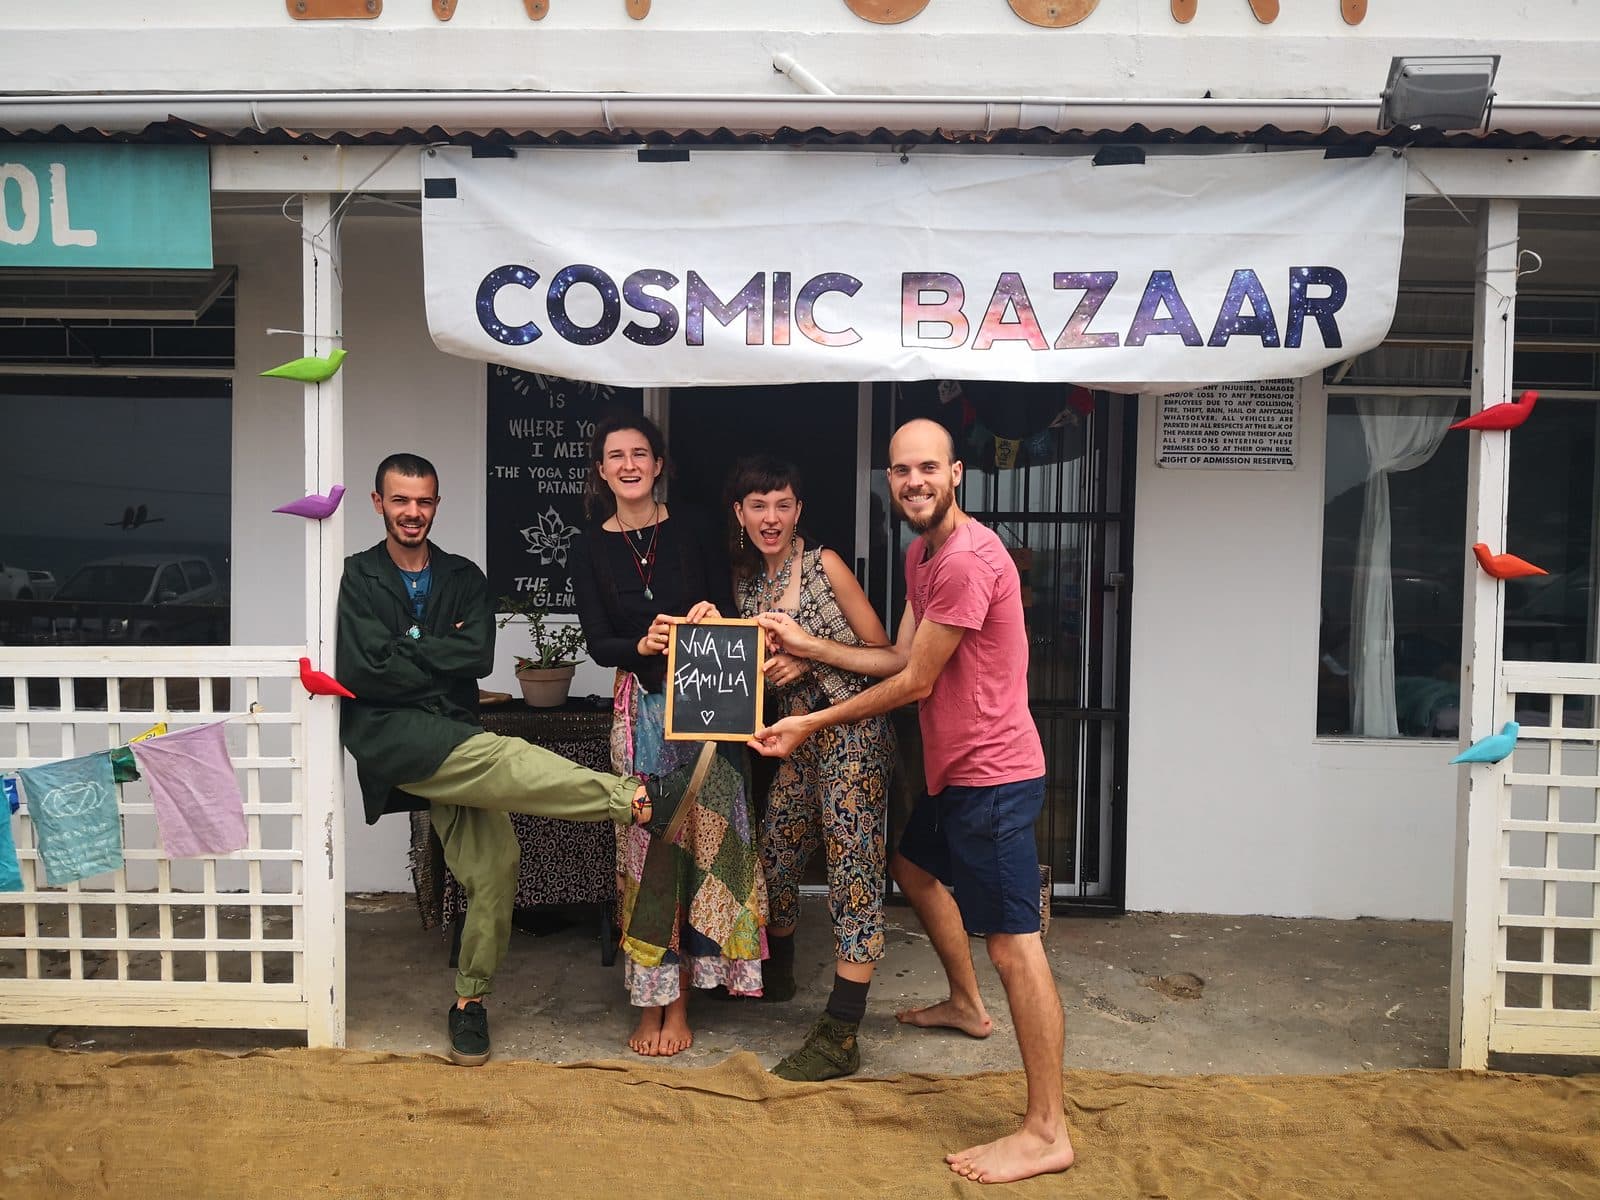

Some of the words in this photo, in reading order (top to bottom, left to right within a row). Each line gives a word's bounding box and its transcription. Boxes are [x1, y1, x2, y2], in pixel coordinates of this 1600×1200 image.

[476, 264, 863, 347] COSMIC
[901, 266, 1348, 350] BAZAAR
[509, 418, 565, 439] WHERE
[531, 442, 544, 457] I
[528, 466, 562, 479] YOGA
[514, 577, 549, 592] THE
[680, 628, 722, 670] VIVA
[727, 639, 746, 661] LA
[674, 662, 749, 700] FAMILIA
